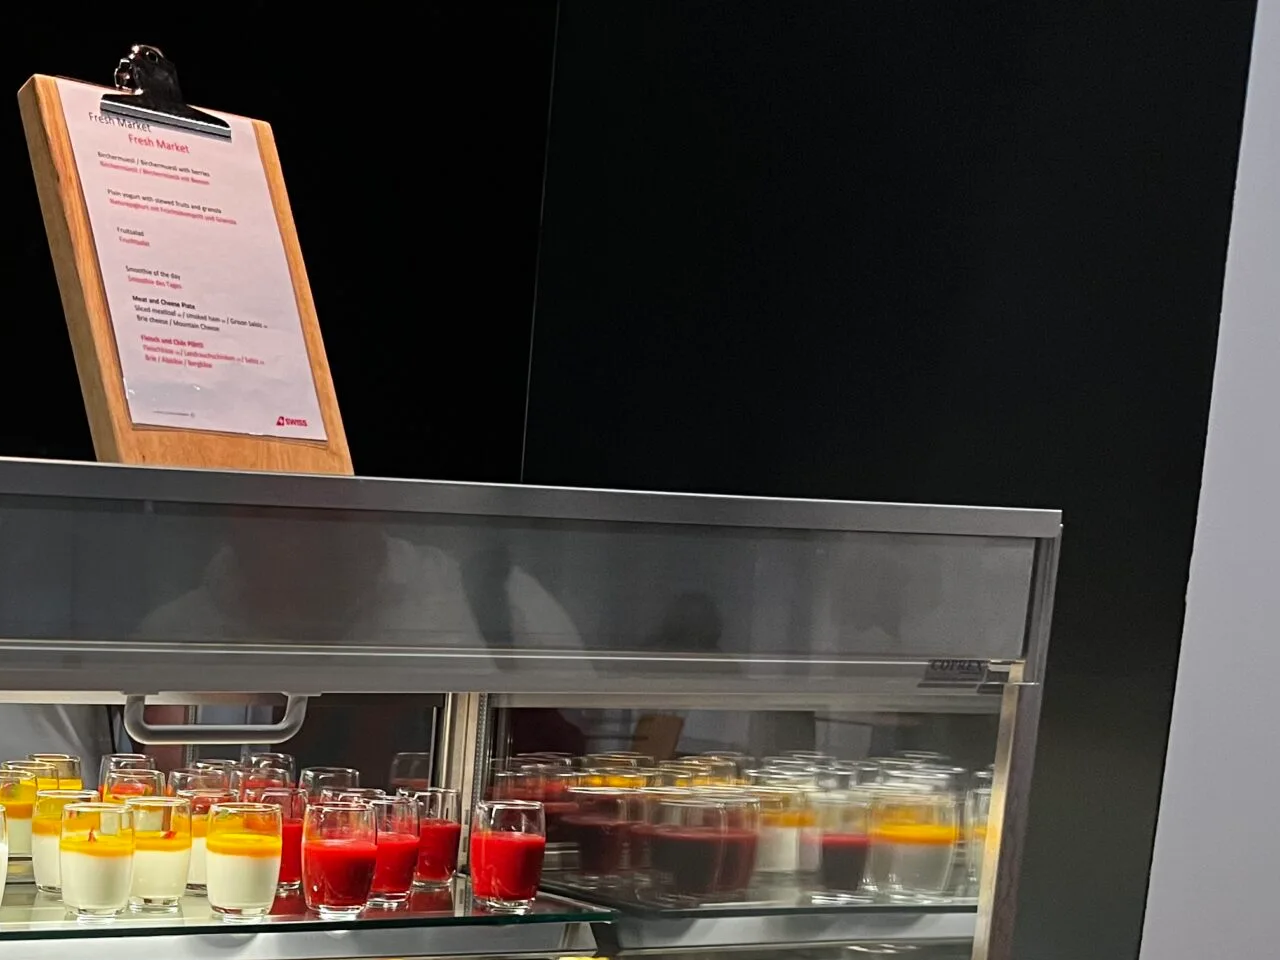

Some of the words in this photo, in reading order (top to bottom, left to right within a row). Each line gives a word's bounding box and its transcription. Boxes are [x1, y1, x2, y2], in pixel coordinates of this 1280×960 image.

[88, 112, 115, 126] Fresh
[117, 118, 152, 132] Market
[128, 134, 154, 147] Fresh
[156, 139, 190, 154] Market
[125, 265, 152, 276] Smoothie
[160, 270, 169, 279] the
[171, 272, 181, 281] day
[132, 295, 148, 303] Meat
[160, 299, 180, 308] Cheese
[173, 319, 200, 329] Mountain
[200, 323, 220, 332] Cheese
[285, 418, 308, 427] SWISS
